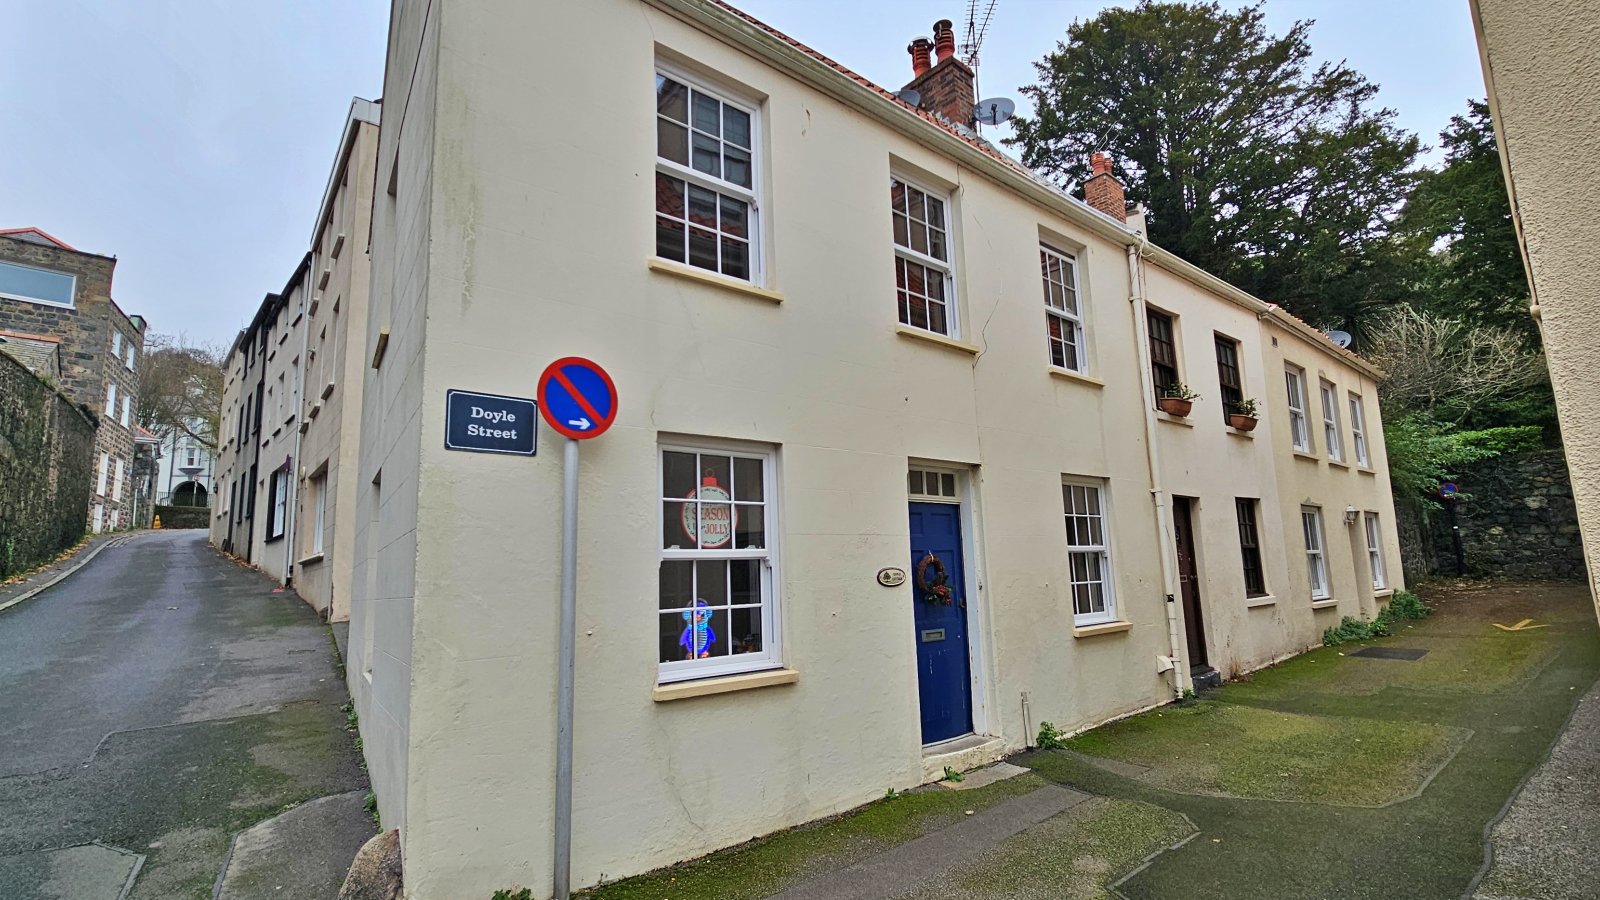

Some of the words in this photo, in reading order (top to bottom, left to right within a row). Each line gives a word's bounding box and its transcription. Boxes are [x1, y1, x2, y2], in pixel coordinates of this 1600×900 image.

[470, 406, 516, 423] Doyle
[467, 424, 518, 439] Street
[704, 523, 729, 535] JOLLY
